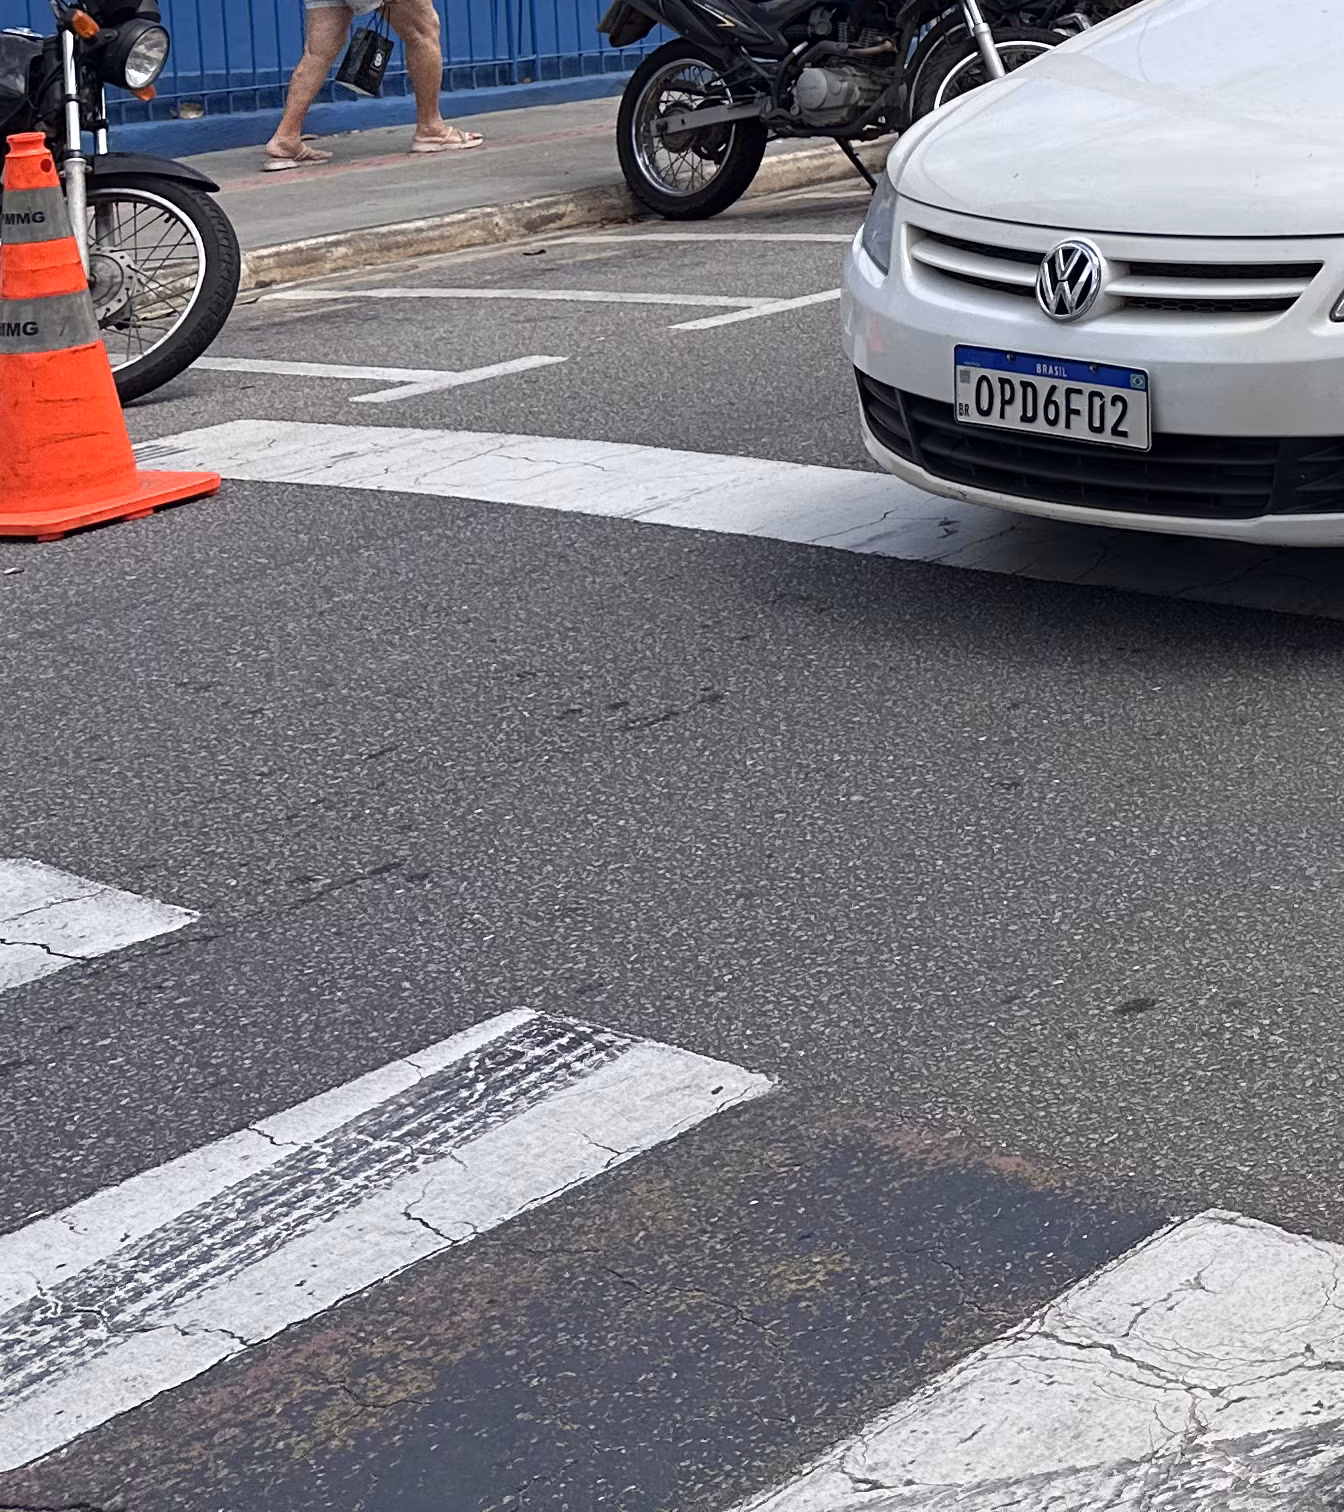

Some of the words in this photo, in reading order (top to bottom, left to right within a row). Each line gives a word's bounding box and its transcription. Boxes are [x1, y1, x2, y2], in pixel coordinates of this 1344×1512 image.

[1035, 362, 1068, 378] BRASIL
[958, 402, 970, 418] BR
[975, 374, 1129, 438] OPD6F02
